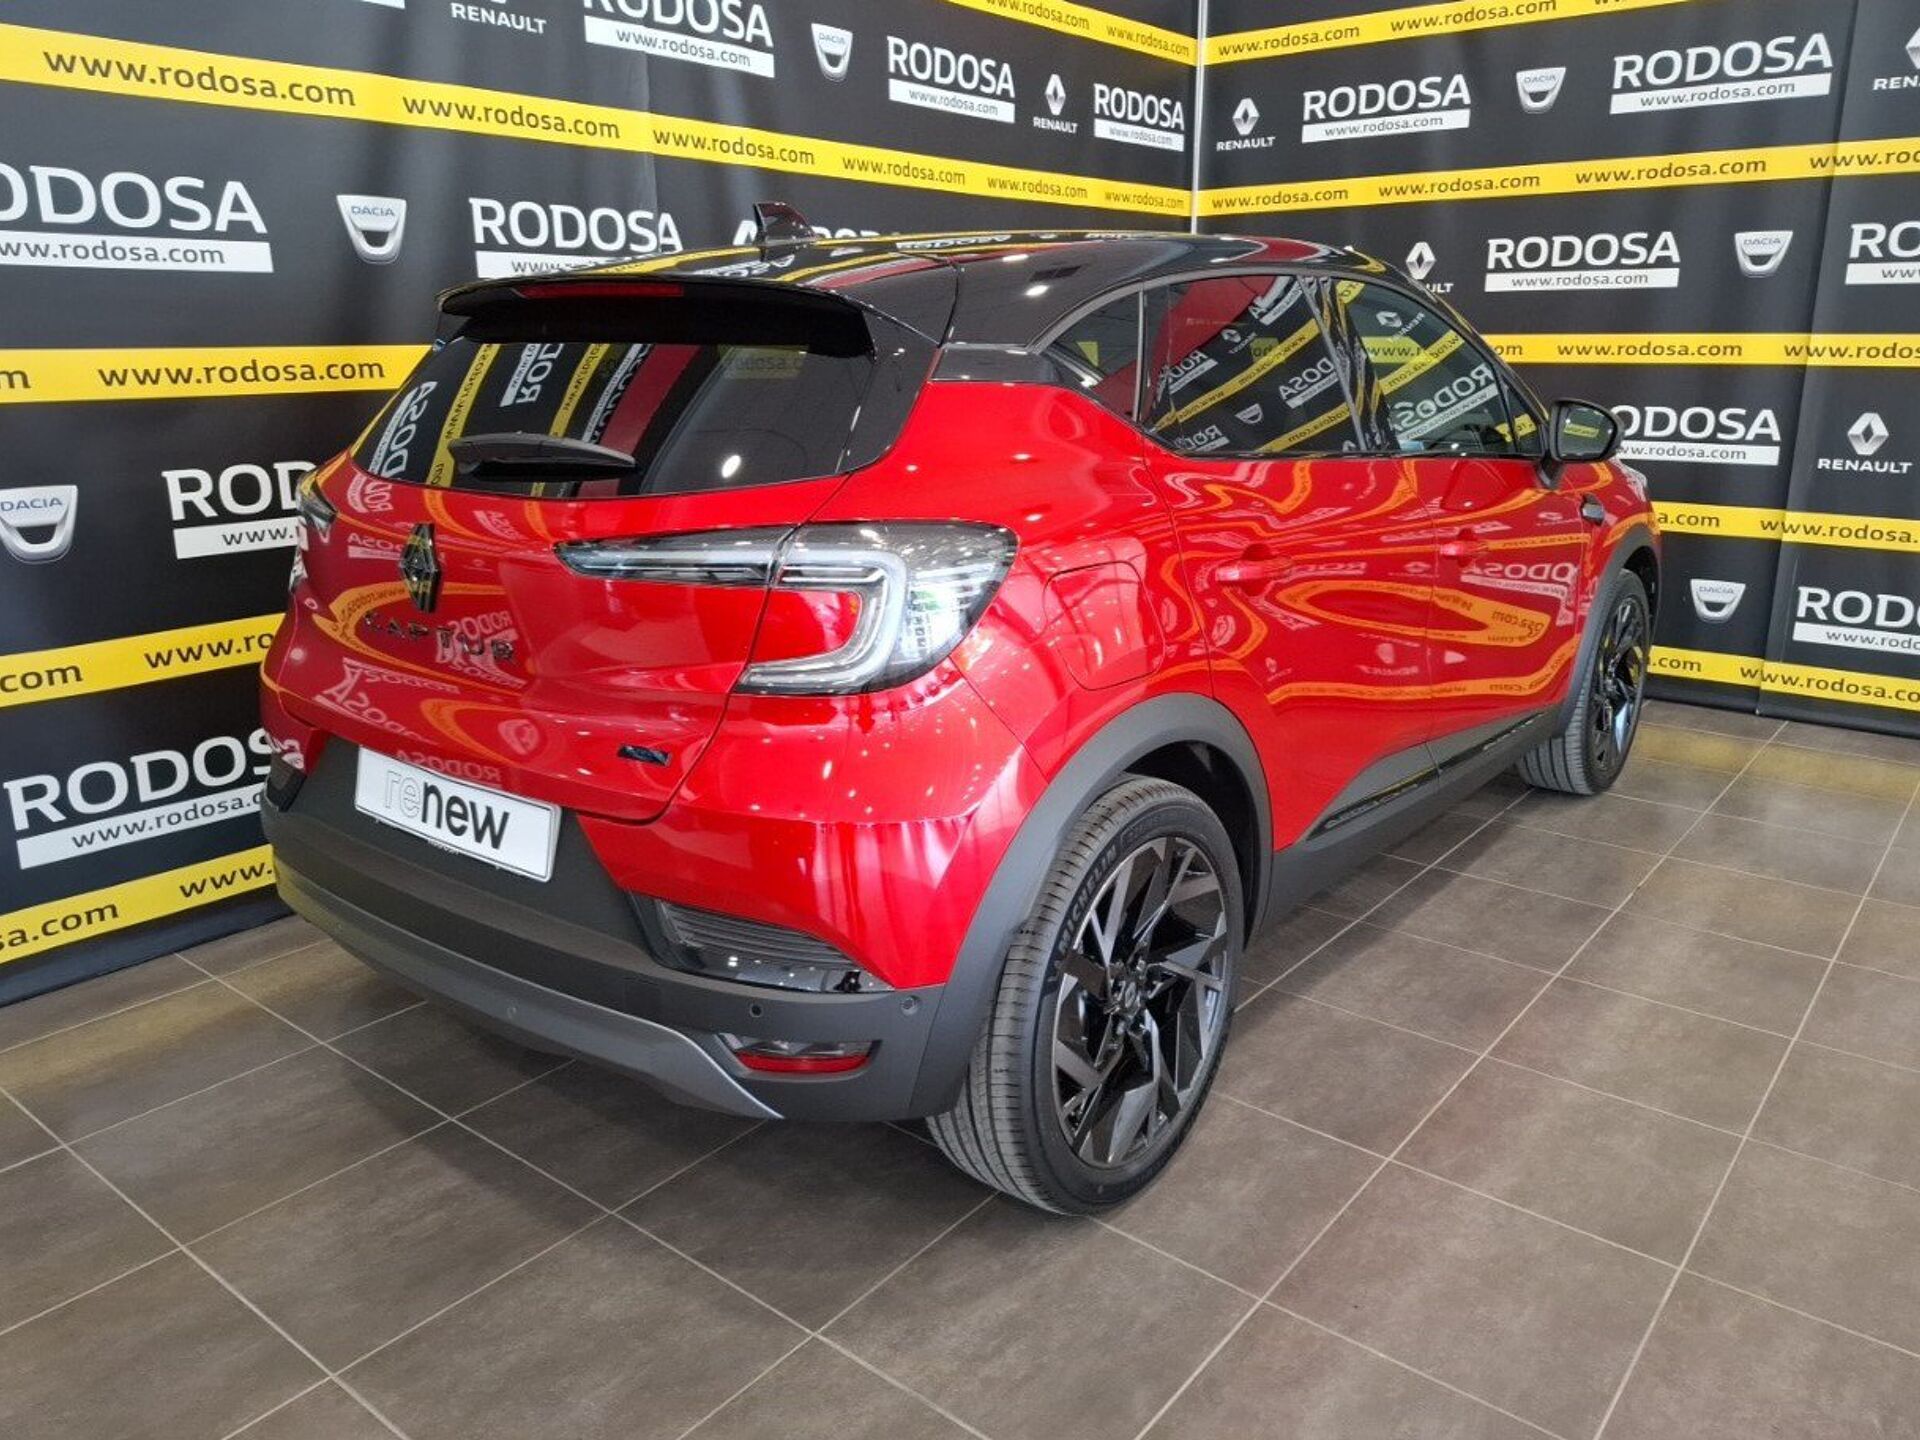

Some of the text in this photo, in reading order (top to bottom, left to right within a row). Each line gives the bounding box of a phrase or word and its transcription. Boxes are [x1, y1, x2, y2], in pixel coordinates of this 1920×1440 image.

[451, 4, 547, 34] RENAULT
[584, 0, 774, 48] DOSA
[1390, 0, 1557, 32] www.rodosa.com
[616, 28, 752, 67] www.rodosa.com
[1106, 24, 1190, 57] www.rodosa.com
[1218, 24, 1361, 57] www.rodosa.com
[886, 35, 1016, 98] RODOSA
[1612, 32, 1833, 89] RODOSA
[43, 51, 356, 106] www.rodosa.com
[1872, 75, 1920, 91] REN
[908, 88, 999, 117] www.rodosa.com
[1093, 83, 1185, 130] RODOSA
[1302, 74, 1472, 121] RODOSA
[1640, 81, 1796, 108] www.rodosa.com
[402, 96, 621, 139] www.rodosa.com
[1033, 116, 1078, 134] RENAULT
[1324, 115, 1444, 138] www.rodosa.com
[653, 128, 816, 165] www.rodosa.com
[1216, 136, 1276, 152] RENAULT
[842, 155, 966, 186] www.rodosa.com
[1378, 173, 1541, 197] www.rodosa.com
[1576, 157, 1767, 184] www.rodosa.com
[987, 176, 1089, 200] www.rodosa.com
[1105, 186, 1185, 209] www.rodosa.com
[1212, 187, 1349, 210] www.rodosa.com
[351, 206, 395, 217] DACIA
[468, 198, 683, 253] RODOSA
[1487, 231, 1681, 269] RODOSA
[1511, 271, 1649, 288] www.rodosa.com
[1557, 341, 1743, 357] www.rodosa.com
[98, 359, 385, 388] www.rodosa.com
[1817, 458, 1913, 474] RENAULT
[1796, 586, 1920, 629] ROD
[384, 770, 510, 850] renew
[0, 903, 119, 950] a.com
